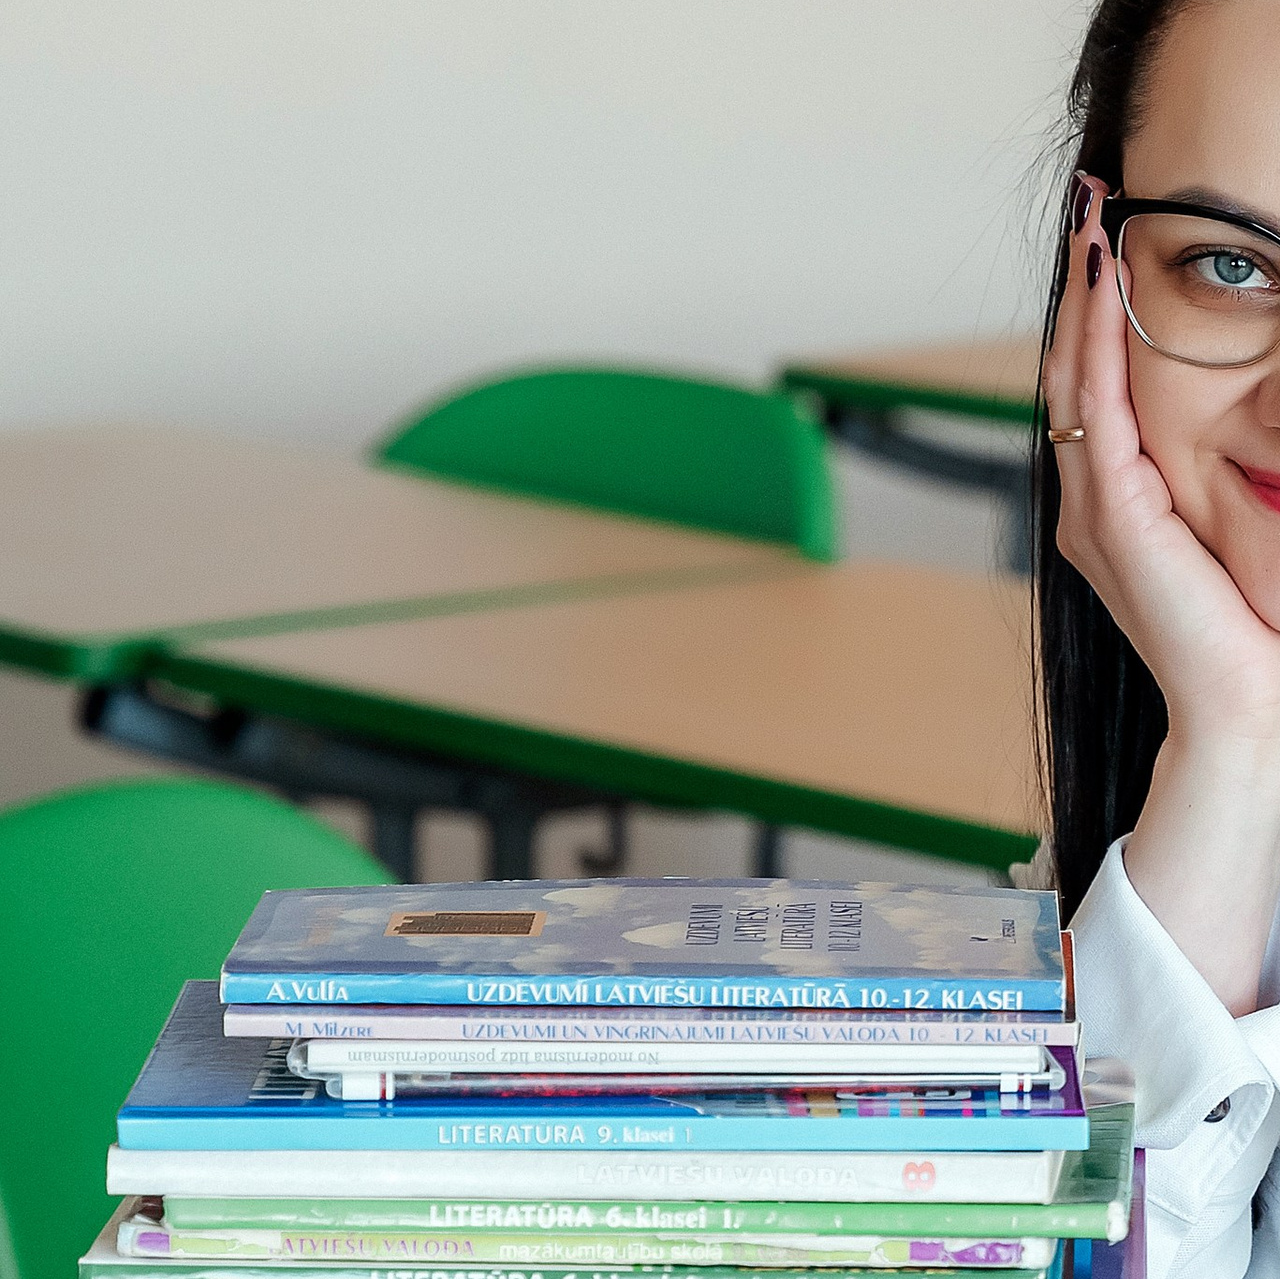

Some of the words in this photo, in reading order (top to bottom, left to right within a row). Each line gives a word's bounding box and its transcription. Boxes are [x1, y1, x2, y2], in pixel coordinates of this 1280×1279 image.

[685, 904, 724, 945] UZDEVUMI
[466, 983, 589, 1004] UZDEVUMI
[595, 980, 704, 1005] LATVIEŠU
[710, 982, 850, 1008] LITERATŪRĀ
[942, 990, 1024, 1010] KLASEI
[461, 1024, 556, 1039] UZDEVUMI
[562, 1025, 588, 1040] UN
[985, 1027, 1049, 1043] KLASEI
[348, 1048, 496, 1064] postmodernismam
[534, 1051, 633, 1065] modernisma
[638, 1051, 660, 1065] No
[438, 1123, 585, 1145] LITERATŪRA
[597, 1125, 618, 1144] 9.
[622, 1126, 675, 1144] klasei
[575, 1159, 724, 1187] LATVIEŠU
[732, 1165, 861, 1188] VALODA
[429, 1202, 593, 1229] LITERATŪRA
[635, 1205, 707, 1229] klasei
[269, 1232, 373, 1257] ATVIEŠU
[383, 1238, 475, 1257] VALODA
